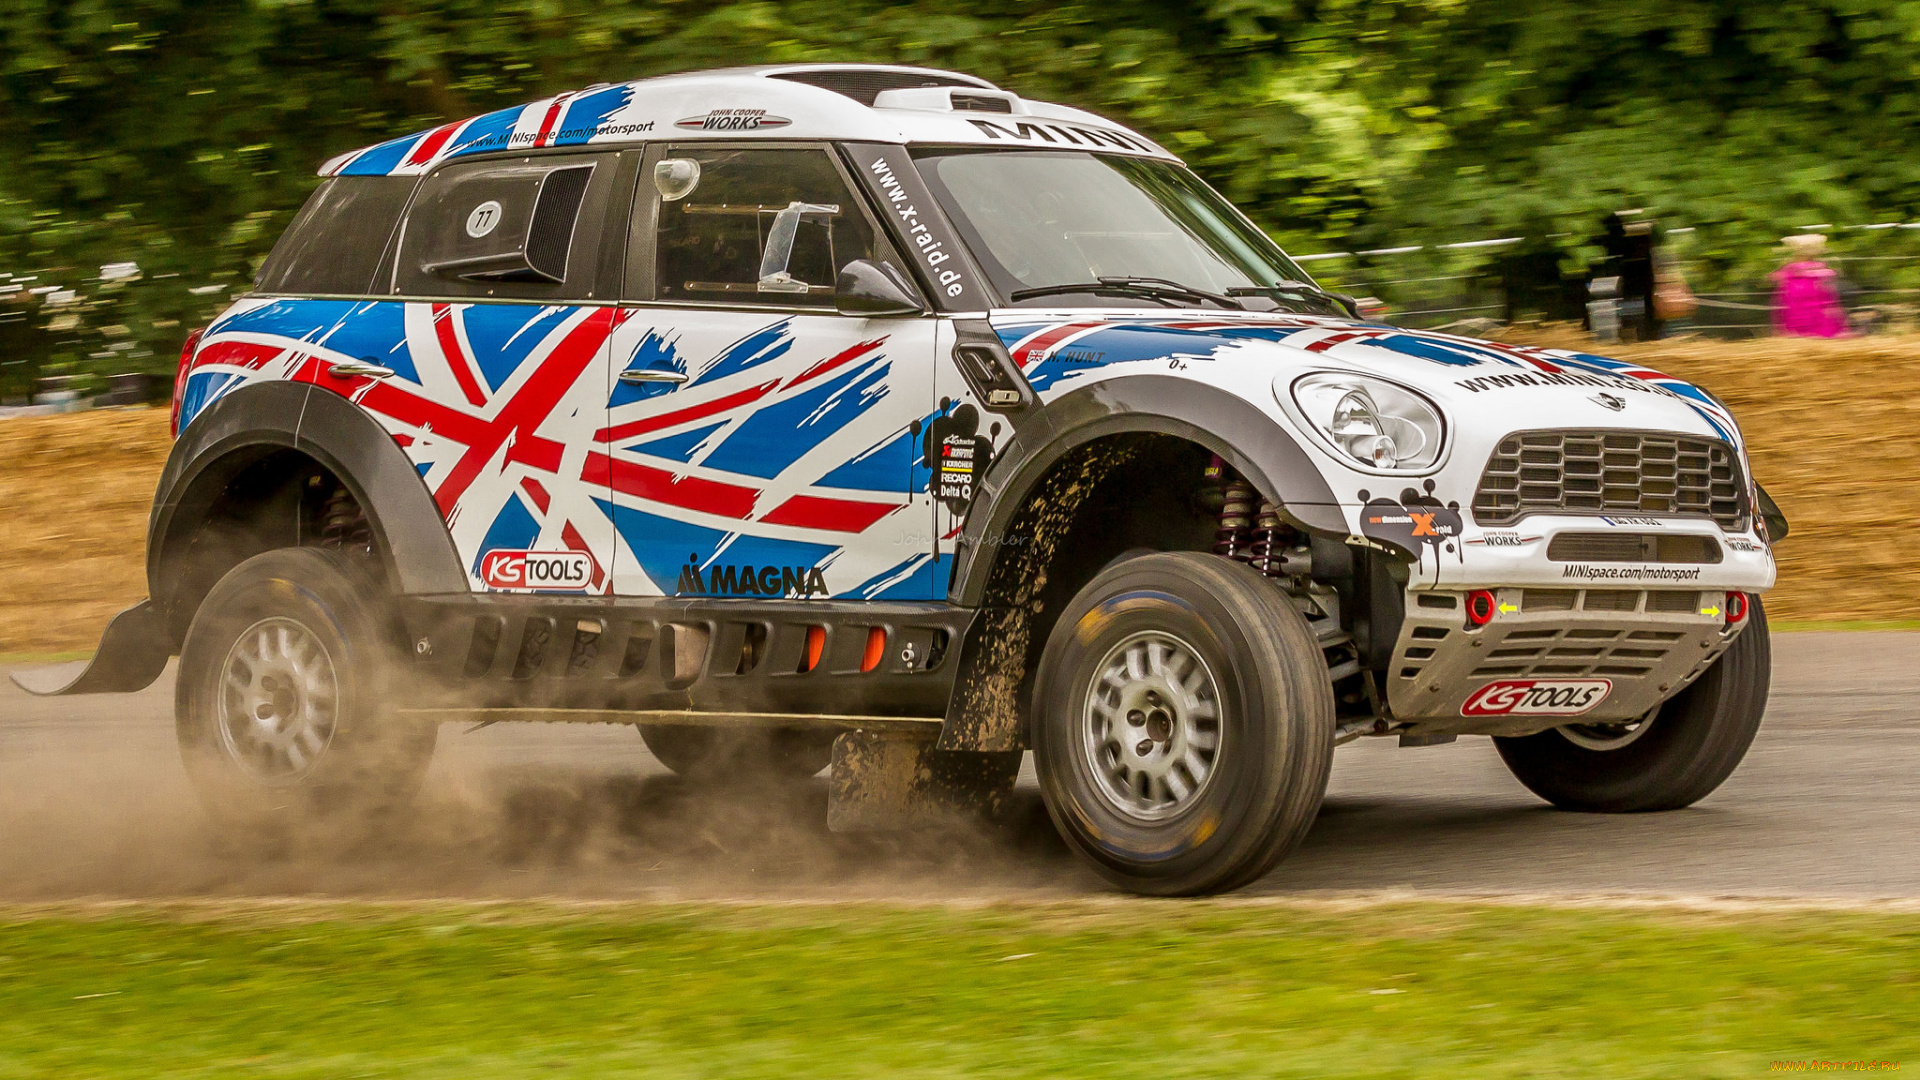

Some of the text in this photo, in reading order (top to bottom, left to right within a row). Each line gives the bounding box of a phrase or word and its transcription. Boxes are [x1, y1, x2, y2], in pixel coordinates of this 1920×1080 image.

[708, 109, 766, 117] JOHN COOPER
[703, 116, 762, 130] WORKS
[467, 120, 655, 148] www.MINIspace.com/motorsport
[966, 119, 1152, 153] MINI
[475, 209, 493, 229] 77
[870, 157, 963, 298] www.x-raid.de
[1065, 351, 1106, 364] HUNT
[941, 473, 972, 484] RECARO
[941, 484, 971, 501] Delta Q
[1484, 536, 1522, 546] WORKS
[488, 556, 583, 583] KS TOOLS
[1563, 564, 1701, 582] MINIspace.com/motorsport
[711, 565, 830, 596] MAGNA
[1468, 685, 1600, 711] KS TOOLS
